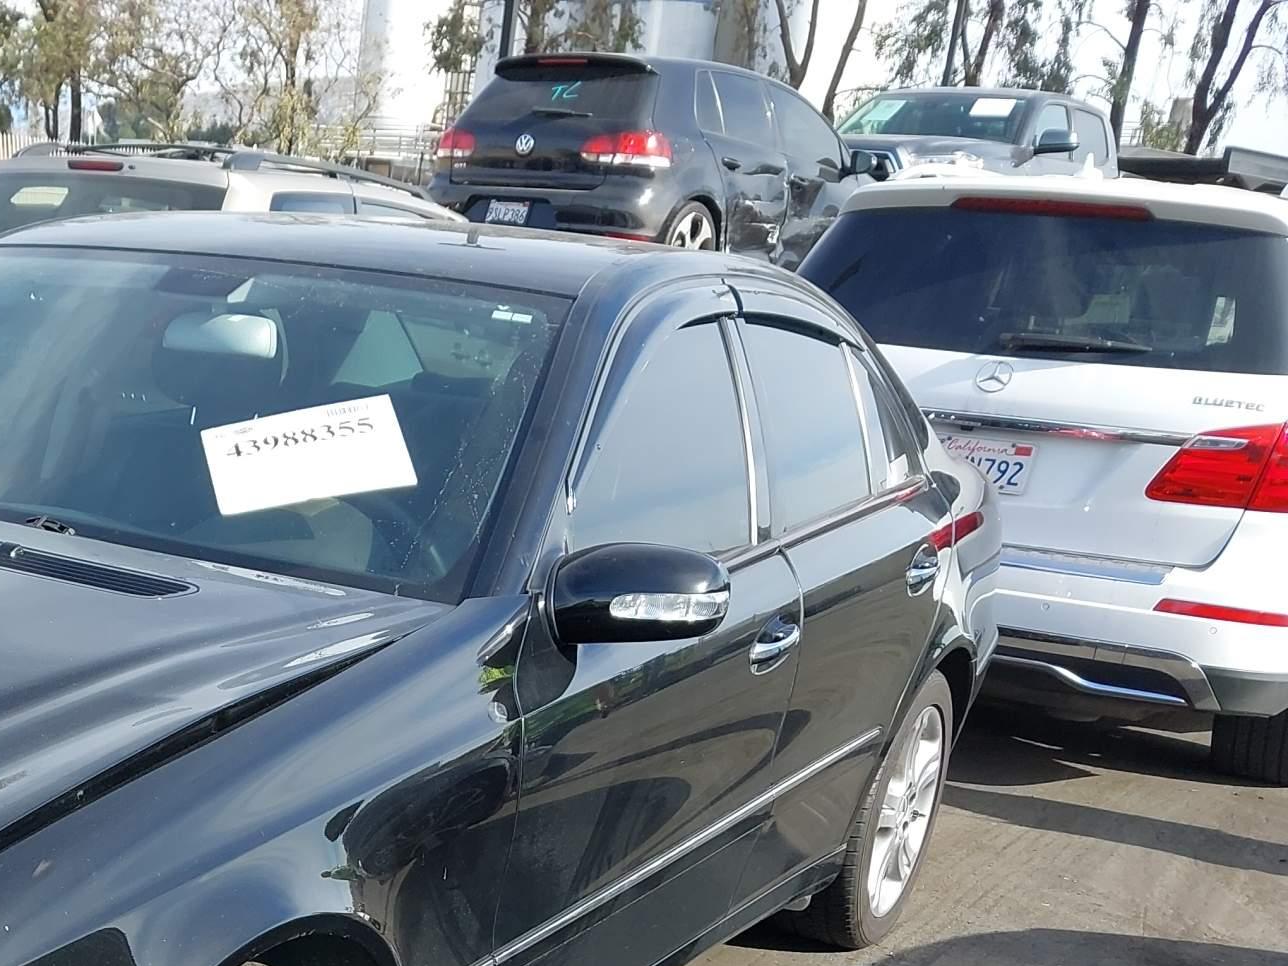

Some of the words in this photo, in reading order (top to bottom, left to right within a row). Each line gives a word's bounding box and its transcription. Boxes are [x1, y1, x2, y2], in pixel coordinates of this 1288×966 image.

[1192, 395, 1265, 412] BLUETEC
[225, 417, 374, 458] 43988355
[947, 438, 1016, 458] California
